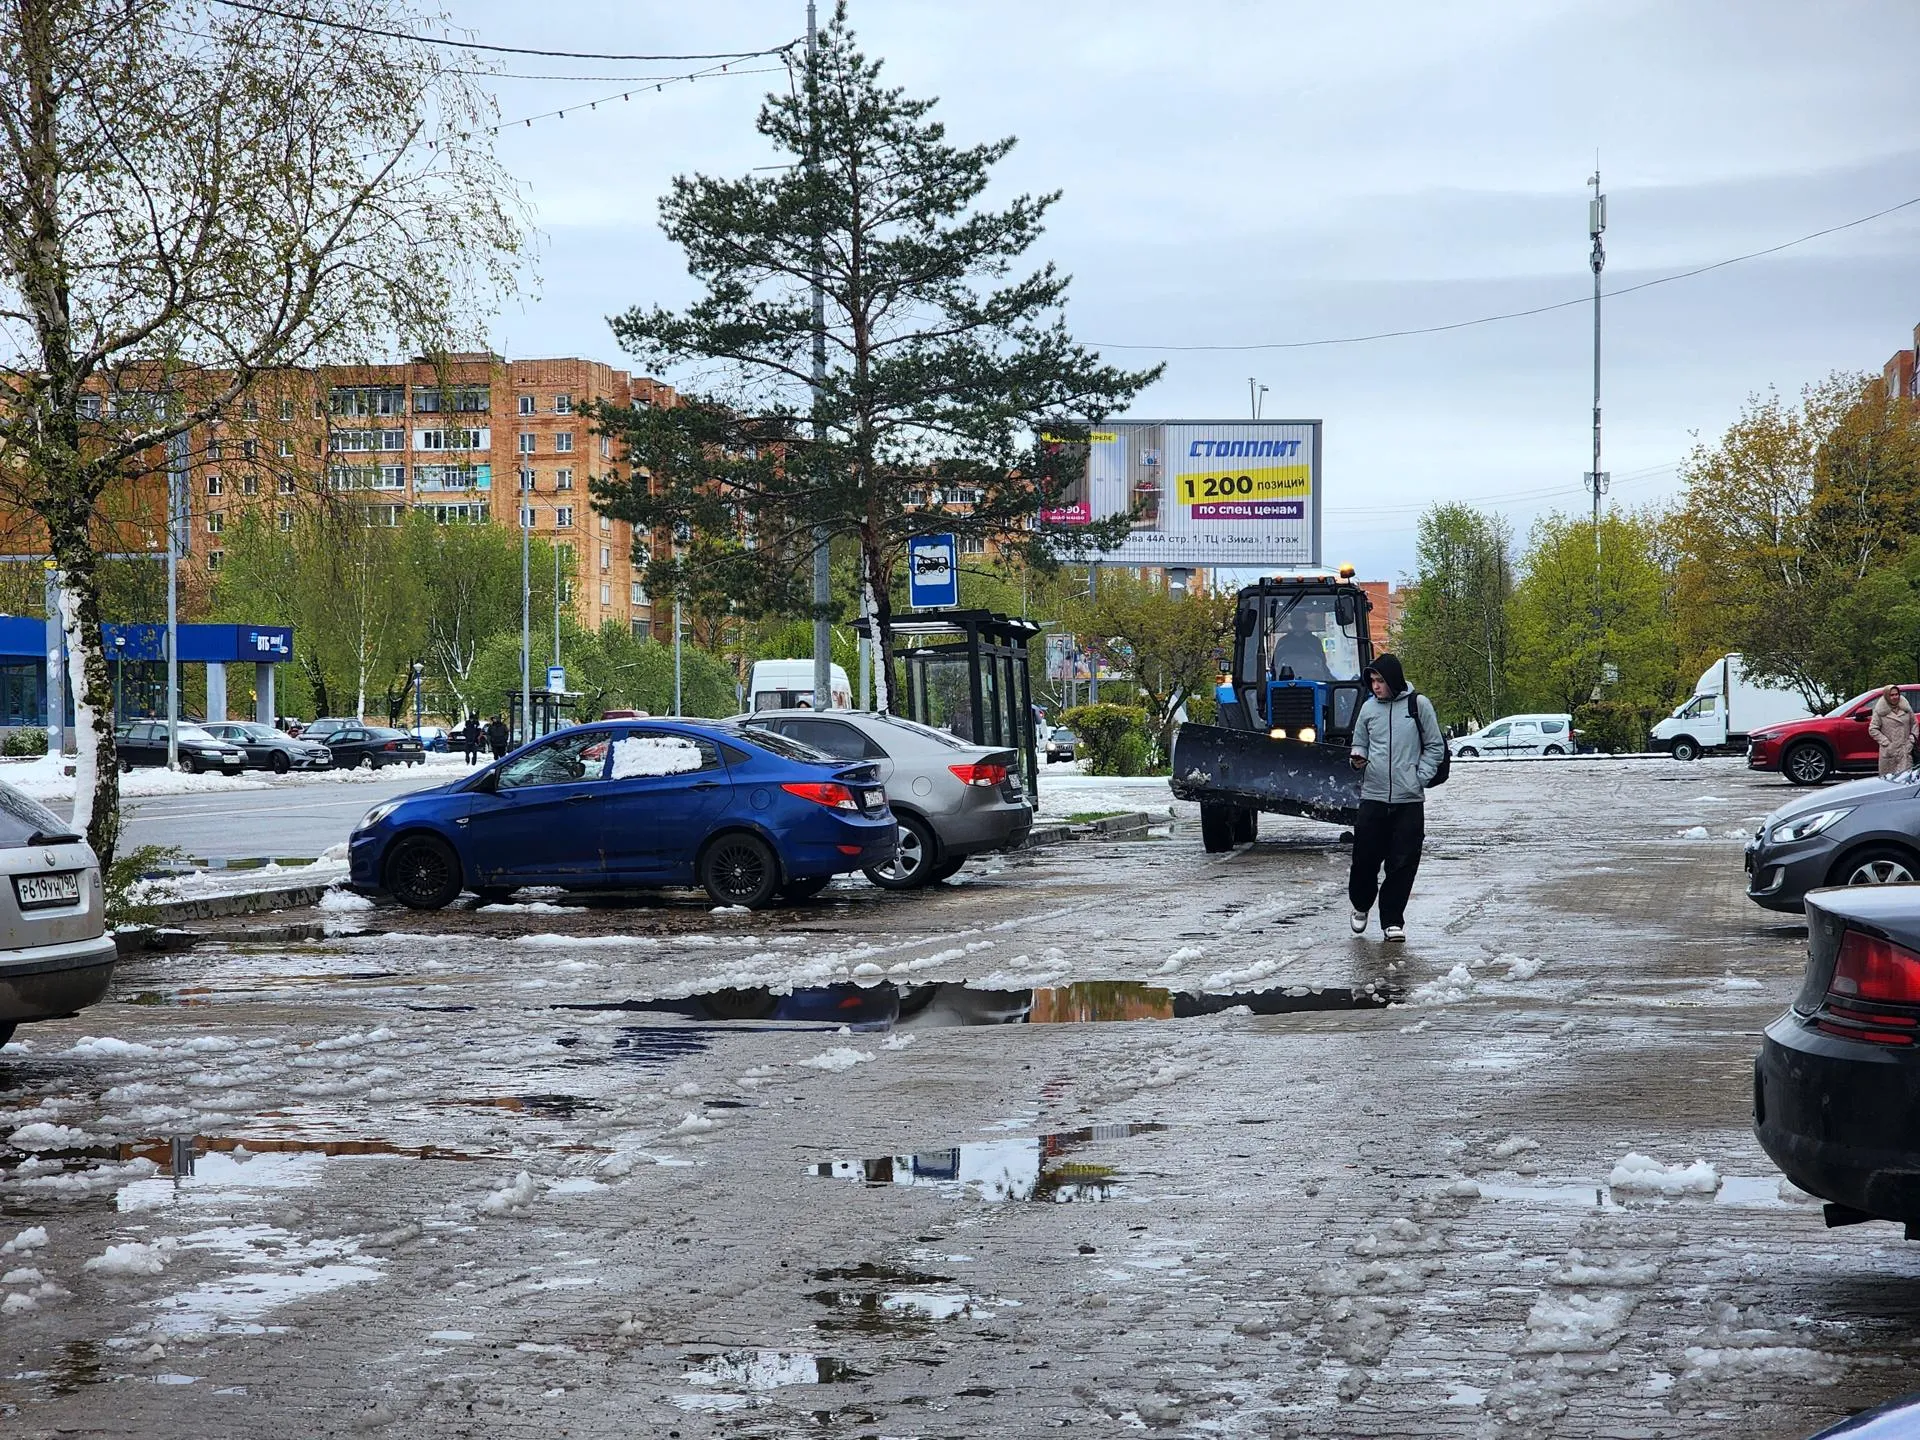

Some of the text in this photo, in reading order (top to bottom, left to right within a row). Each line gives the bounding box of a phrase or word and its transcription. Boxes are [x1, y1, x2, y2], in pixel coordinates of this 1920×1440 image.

[1190, 441, 1301, 457] СТОЛПЛИТ
[1185, 476, 1305, 497] 1 200 позиций
[1199, 506, 1297, 516] по спец ценам
[1146, 534, 1165, 543] 44А
[1168, 536, 1189, 545] стр.
[1204, 535, 1218, 545] ТЦ
[257, 635, 270, 651] ВТБ
